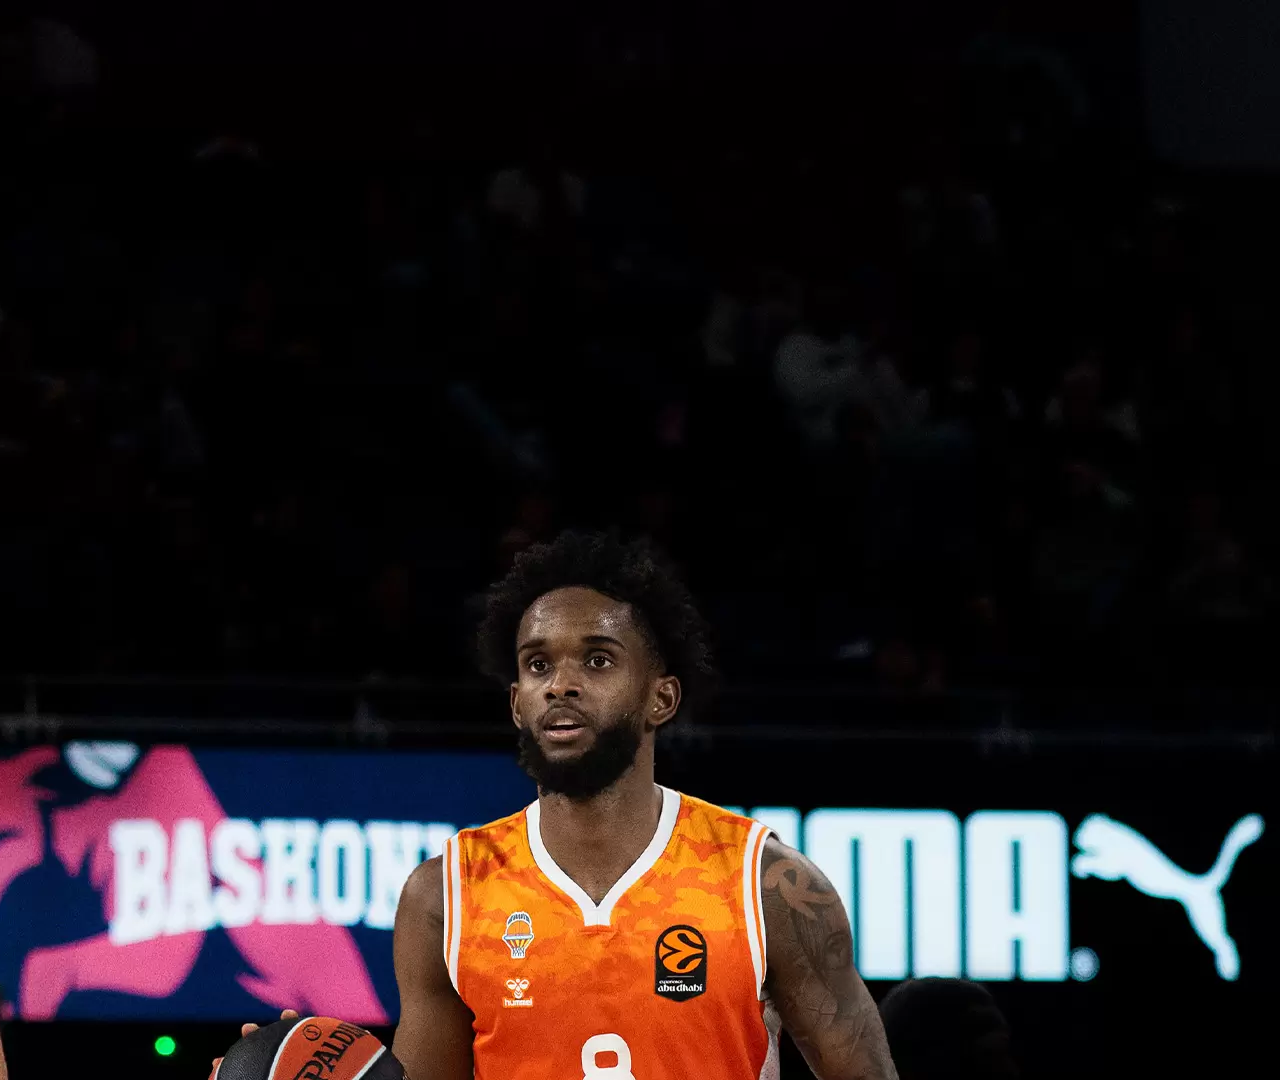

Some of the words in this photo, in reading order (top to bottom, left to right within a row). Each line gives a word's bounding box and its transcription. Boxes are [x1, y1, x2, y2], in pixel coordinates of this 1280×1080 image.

[108, 819, 482, 945] BASKON
[721, 807, 1069, 980] MA
[657, 984, 675, 992] abu
[676, 983, 703, 992] dhabi
